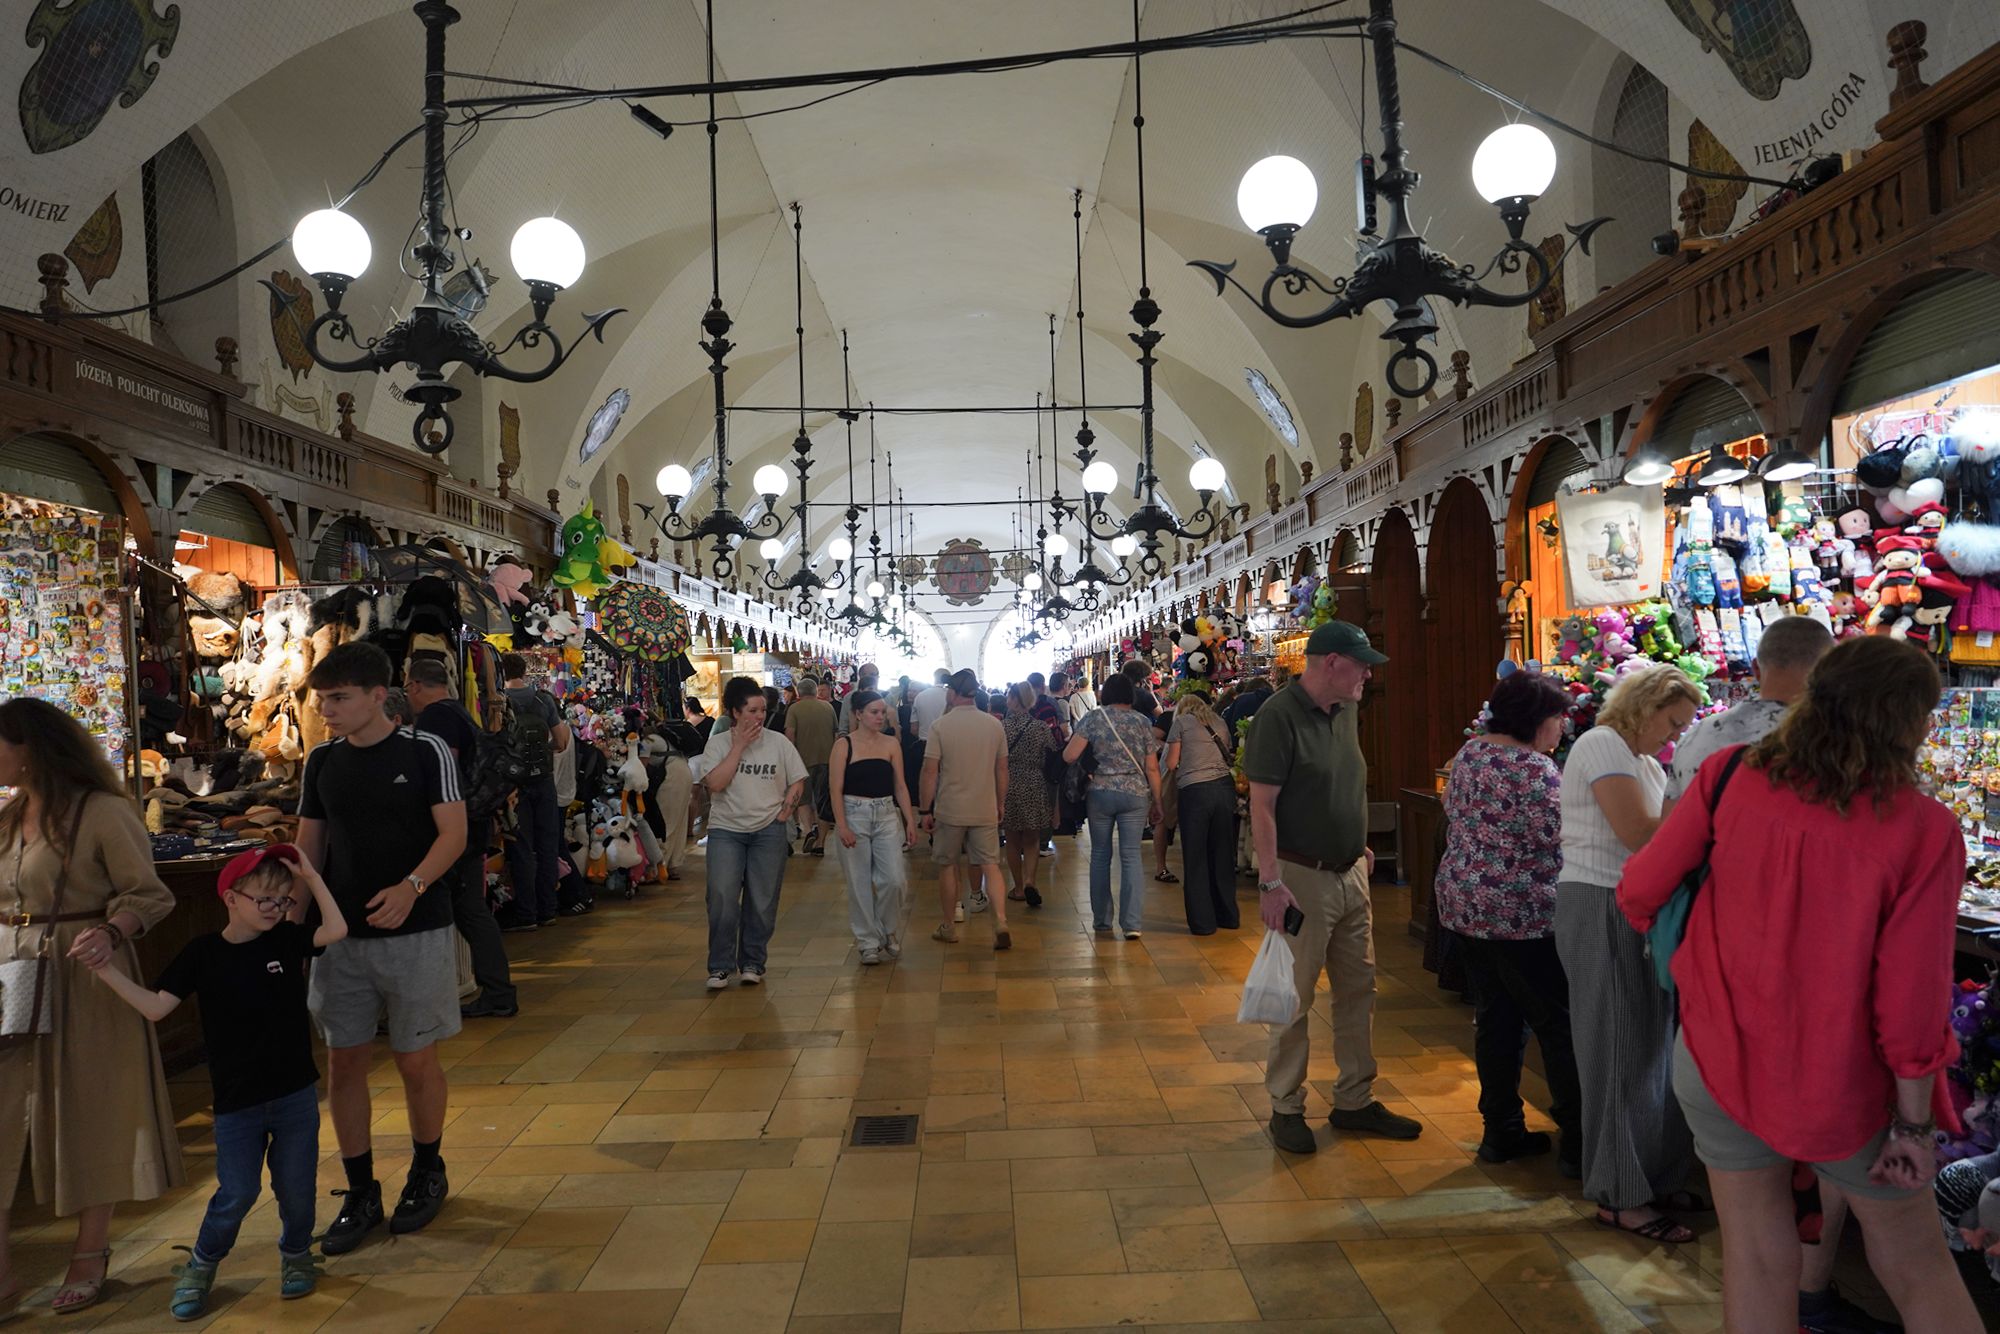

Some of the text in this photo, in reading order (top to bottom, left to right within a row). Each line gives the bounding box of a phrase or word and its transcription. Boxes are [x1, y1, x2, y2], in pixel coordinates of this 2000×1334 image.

[1753, 71, 1866, 166] JELENIA GÓRA
[75, 360, 210, 421] JÓZEFA POLICHT OLEKSOWA
[736, 762, 777, 776] ISURE
